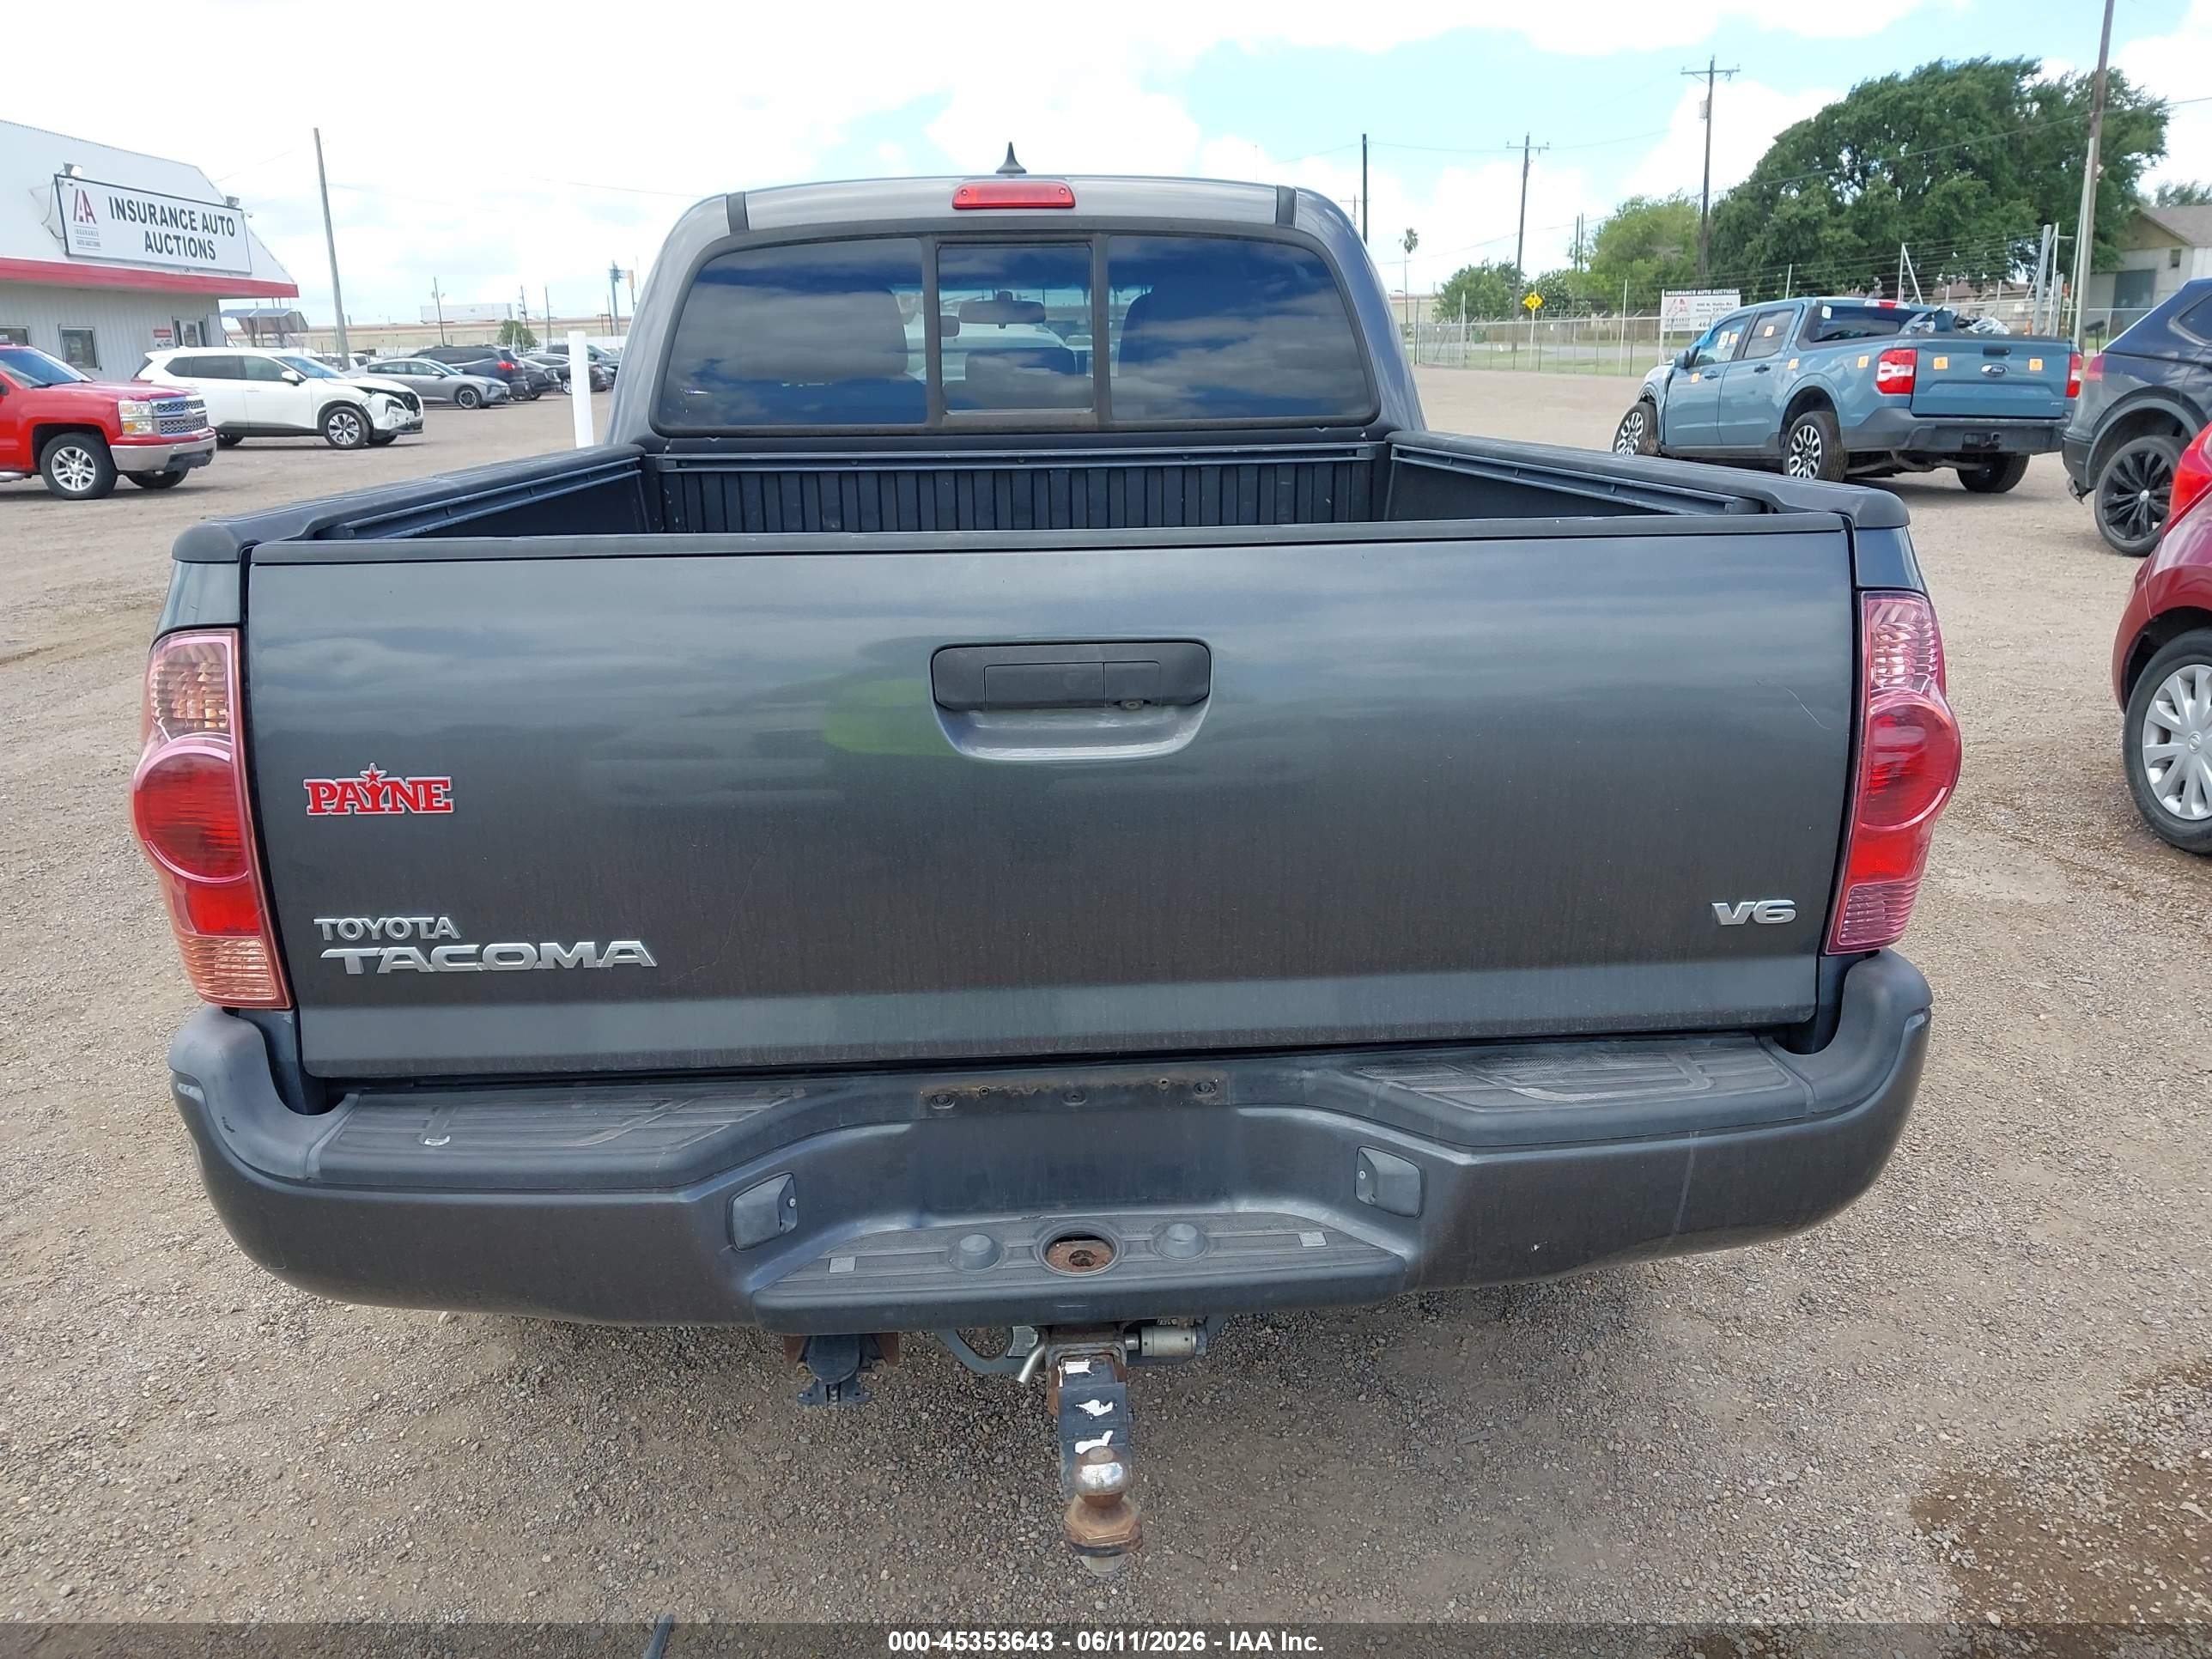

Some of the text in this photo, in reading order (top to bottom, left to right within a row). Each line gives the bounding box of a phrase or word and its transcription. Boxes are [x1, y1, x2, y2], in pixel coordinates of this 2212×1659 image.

[108, 196, 235, 238] INSURANCE AUTO
[144, 230, 216, 261] AUCTIONS
[303, 775, 454, 815] PAYNE
[313, 915, 461, 941] TOYOTA
[1711, 899, 1796, 926] V6
[320, 939, 658, 975] TACOMA
